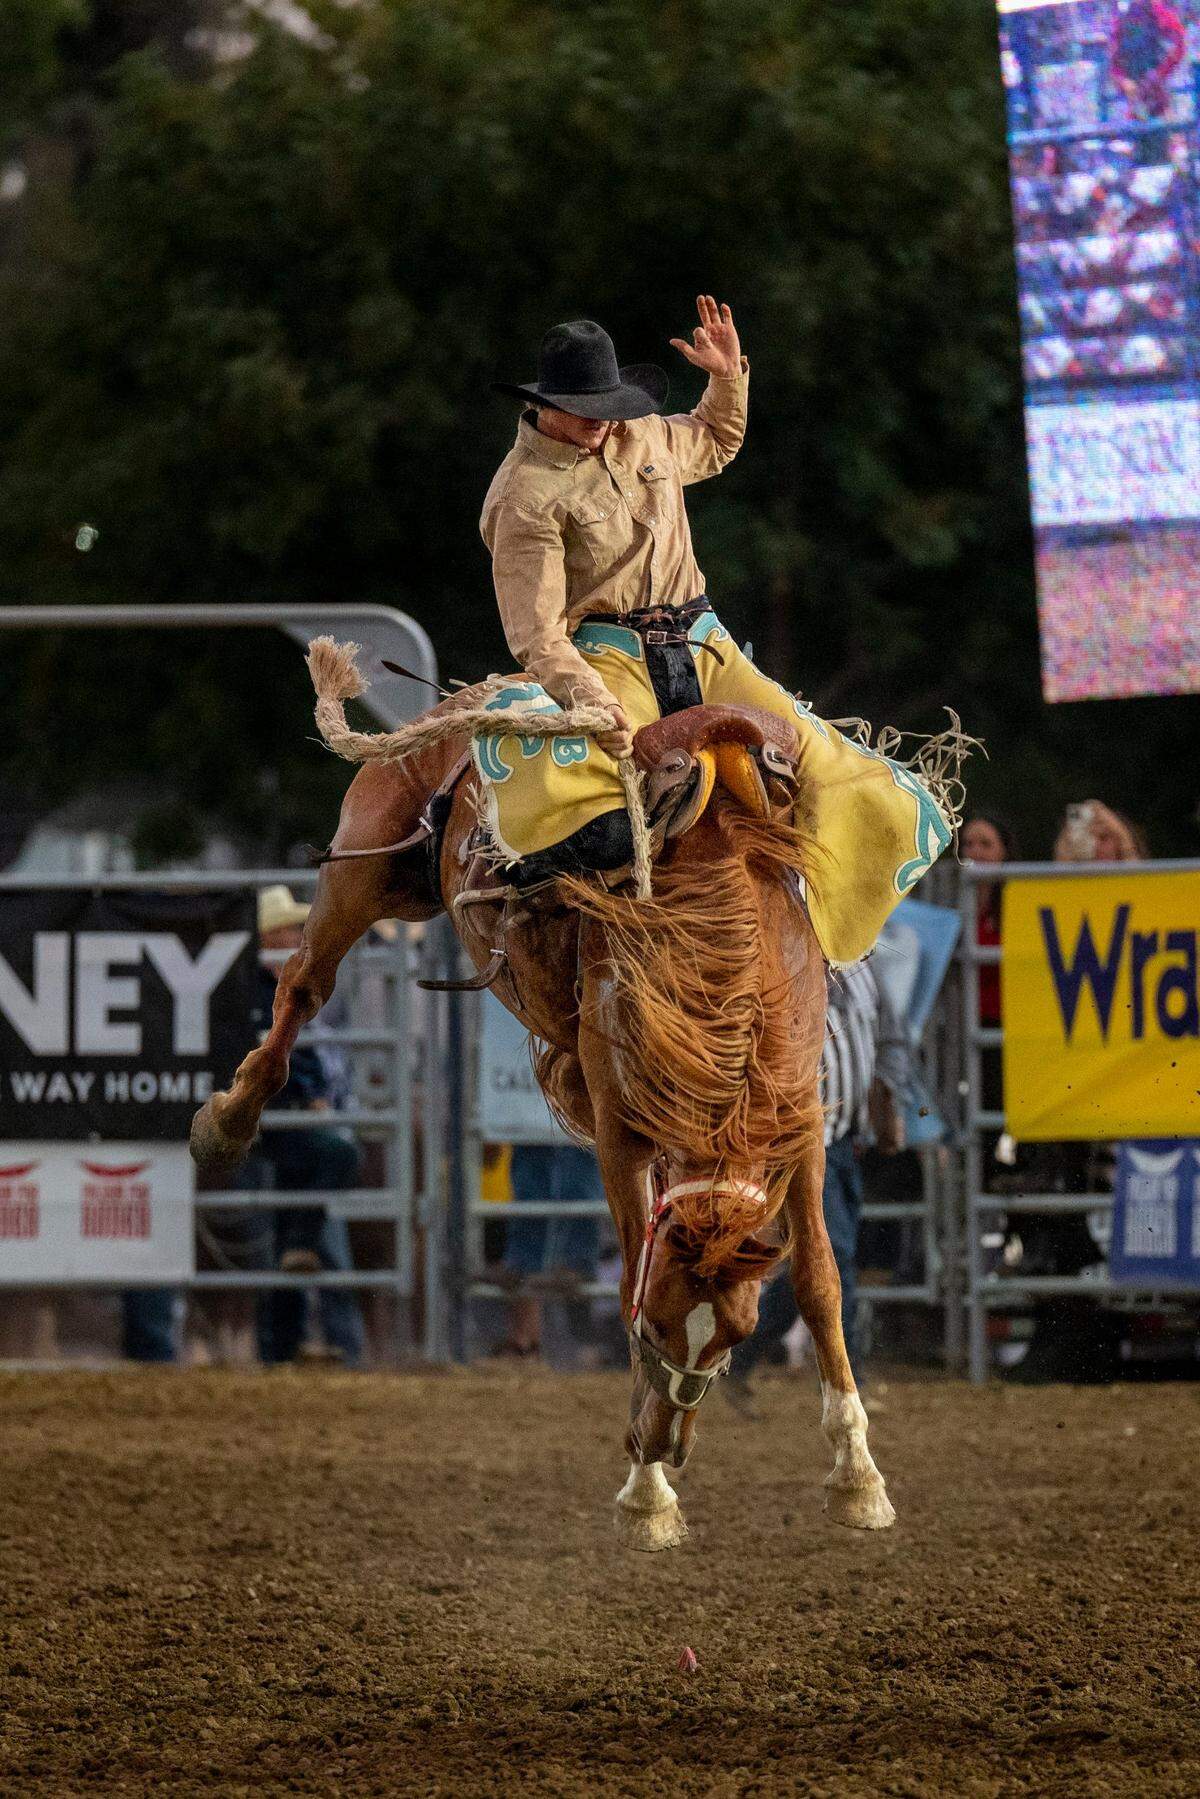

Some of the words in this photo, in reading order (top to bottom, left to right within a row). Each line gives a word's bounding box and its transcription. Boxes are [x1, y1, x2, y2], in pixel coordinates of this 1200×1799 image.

[1040, 904, 1199, 1045] Wra
[9, 1071, 95, 1103] WAY
[104, 1071, 214, 1103] HOME
